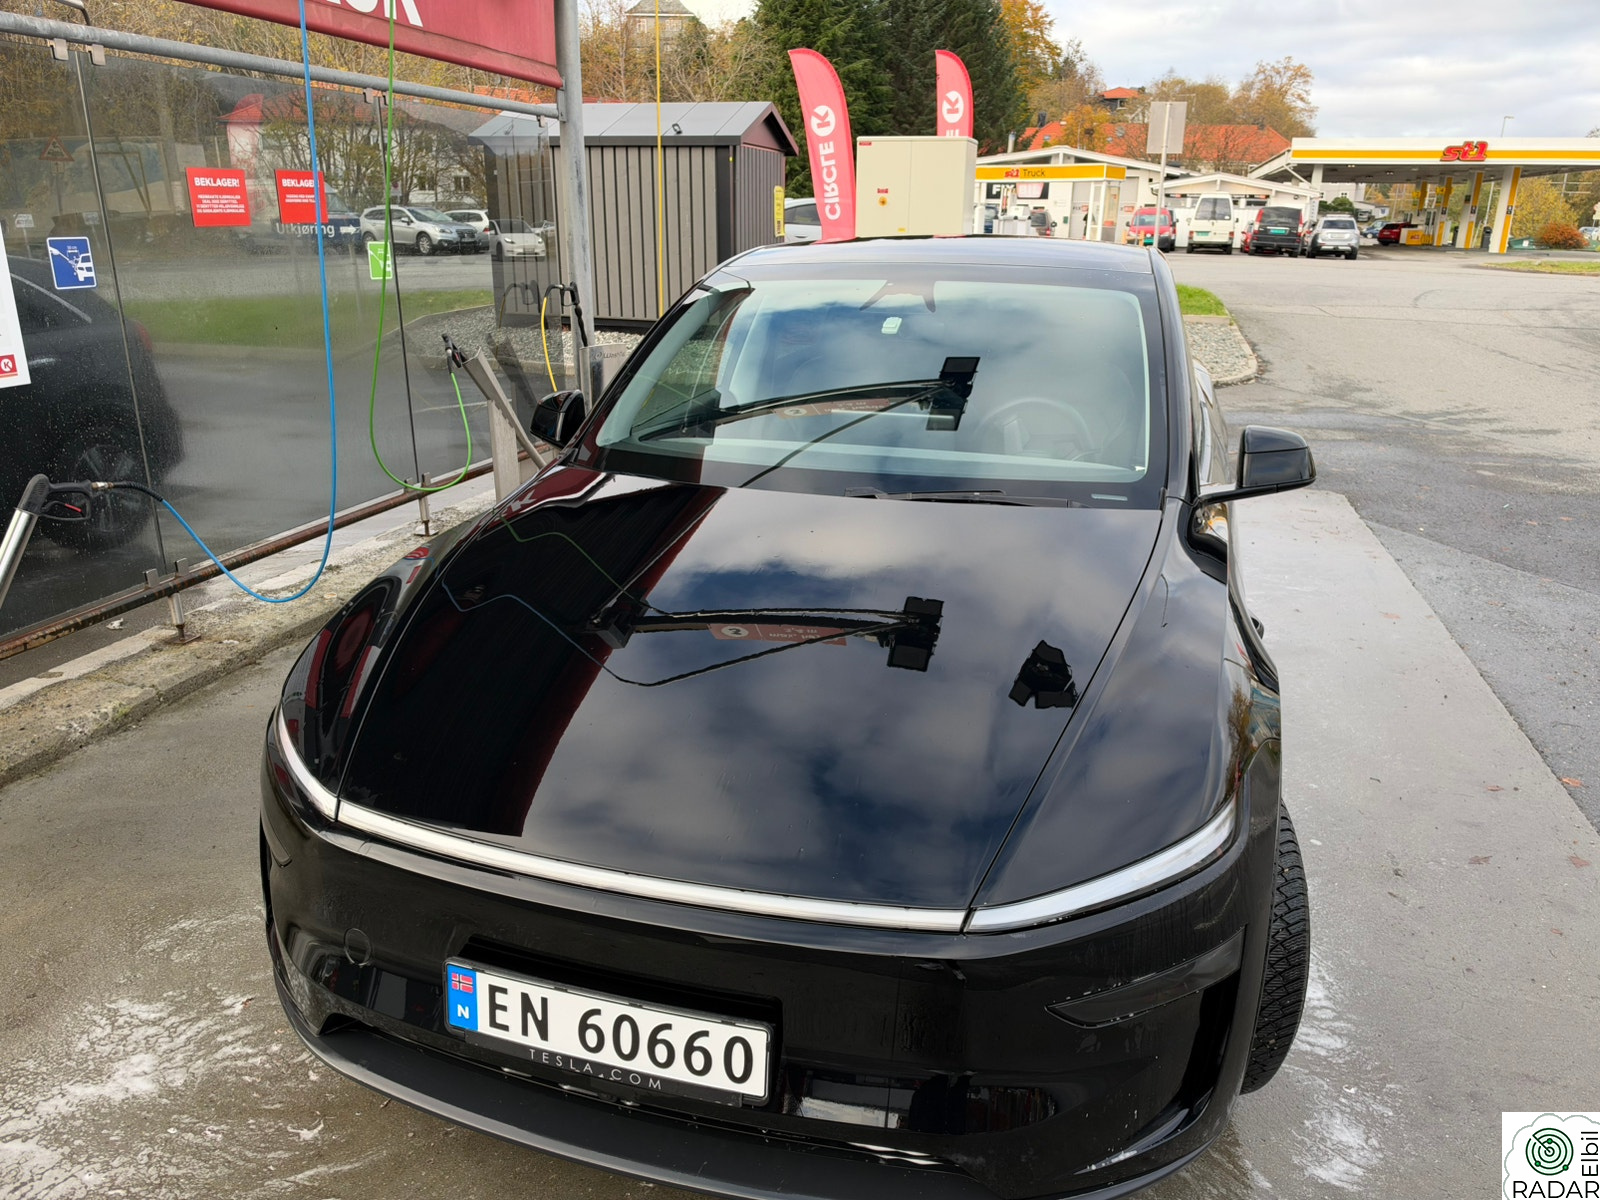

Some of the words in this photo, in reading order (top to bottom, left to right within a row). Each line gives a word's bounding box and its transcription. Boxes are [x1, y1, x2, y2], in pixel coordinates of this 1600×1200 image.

[1023, 169, 1046, 177] Truck
[194, 177, 240, 187] BEKLAGER!
[457, 1004, 470, 1019] N
[488, 984, 549, 1042] EN
[578, 1008, 754, 1085] 60660
[529, 1048, 662, 1090] TESLA.COM
